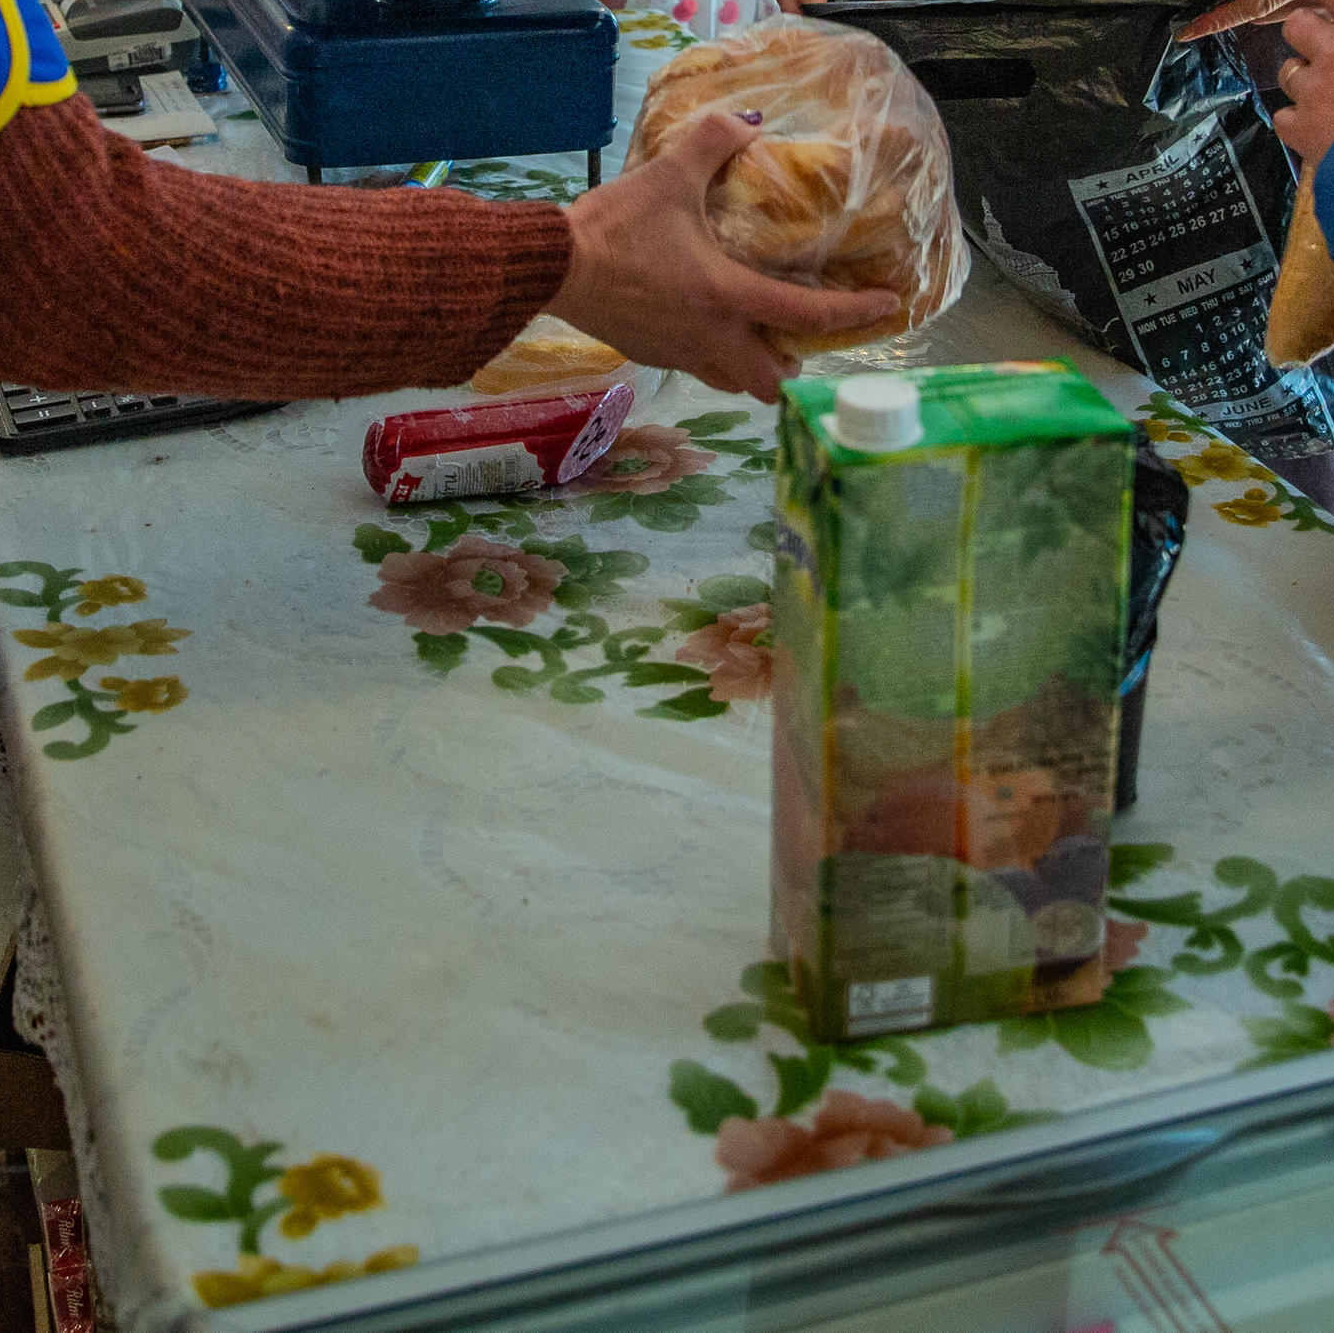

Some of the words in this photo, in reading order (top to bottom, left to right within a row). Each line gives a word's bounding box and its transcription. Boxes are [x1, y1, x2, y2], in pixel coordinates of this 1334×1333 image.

[1126, 155, 1179, 184] APRIL
[1224, 179, 1240, 195] 21
[1110, 248, 1128, 263] 22
[1130, 240, 1147, 254] 23
[1149, 231, 1166, 247] 24
[1169, 223, 1186, 238] 25
[1189, 215, 1206, 231] 26
[1209, 208, 1226, 224] 27
[1230, 201, 1248, 217] 28
[1119, 268, 1135, 284] 29
[1137, 259, 1155, 275] 30
[1177, 268, 1217, 294] MAY
[1137, 321, 1157, 335] MON
[1159, 314, 1177, 327] TUE
[1179, 306, 1199, 319] WED
[1201, 297, 1218, 311] THU
[1239, 283, 1254, 295] SAT
[1257, 272, 1274, 286] SUN
[1196, 323, 1204, 333] 1
[1212, 315, 1223, 326] 2
[1232, 307, 1241, 317] 3
[1252, 297, 1260, 307] 4
[1161, 357, 1171, 368] 6
[1180, 349, 1189, 360] 7
[1201, 342, 1210, 353] 8
[1220, 333, 1228, 344] 9
[1231, 322, 1245, 336] 10
[1162, 375, 1178, 386] 13
[1181, 368, 1197, 379] 14
[1201, 361, 1217, 372] 15
[1220, 351, 1235, 364] 16
[1237, 338, 1251, 353] 17
[1188, 382, 1203, 391] 21
[1206, 376, 1223, 386] 22
[1226, 368, 1242, 382] 23
[1243, 357, 1258, 372] 24
[1211, 389, 1228, 398] 29
[1232, 385, 1248, 395] 30
[1252, 372, 1266, 387] 31
[1222, 397, 1272, 416] JUNE
[1246, 417, 1263, 426] THU
[1283, 404, 1298, 417] SAT
[1302, 390, 1316, 407] SUN
[1313, 406, 1321, 416] 2
[1319, 424, 1327, 433] 9
